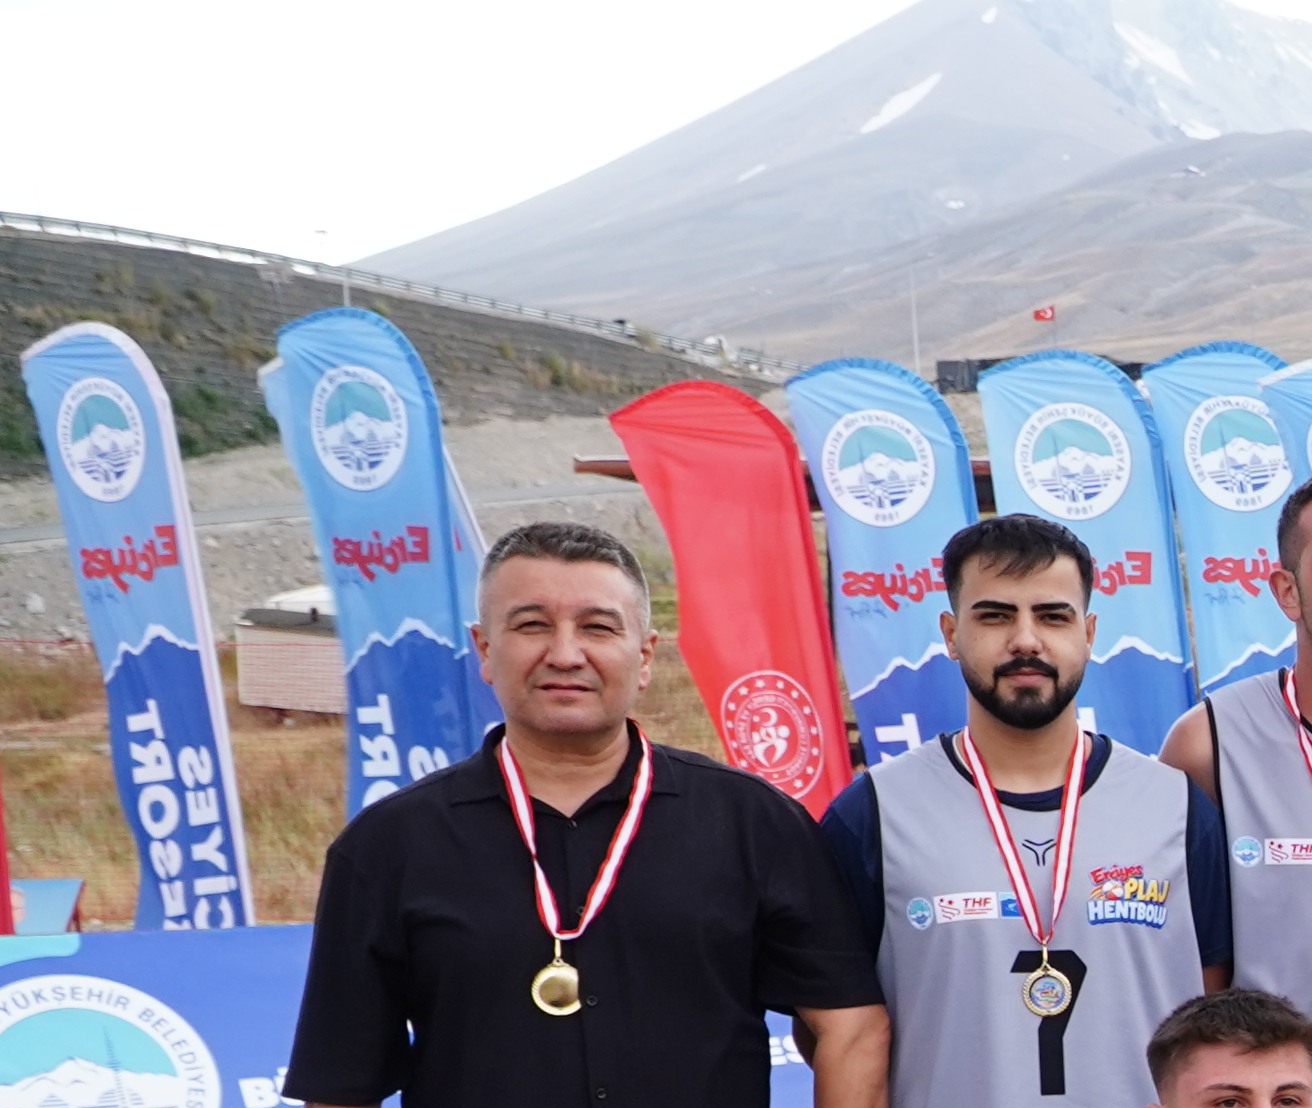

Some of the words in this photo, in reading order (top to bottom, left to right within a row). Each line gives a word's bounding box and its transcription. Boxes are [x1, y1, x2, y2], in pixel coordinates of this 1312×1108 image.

[963, 897, 992, 909] THF
[1123, 878, 1171, 904] PLAJ
[1010, 949, 1088, 1096] 7
